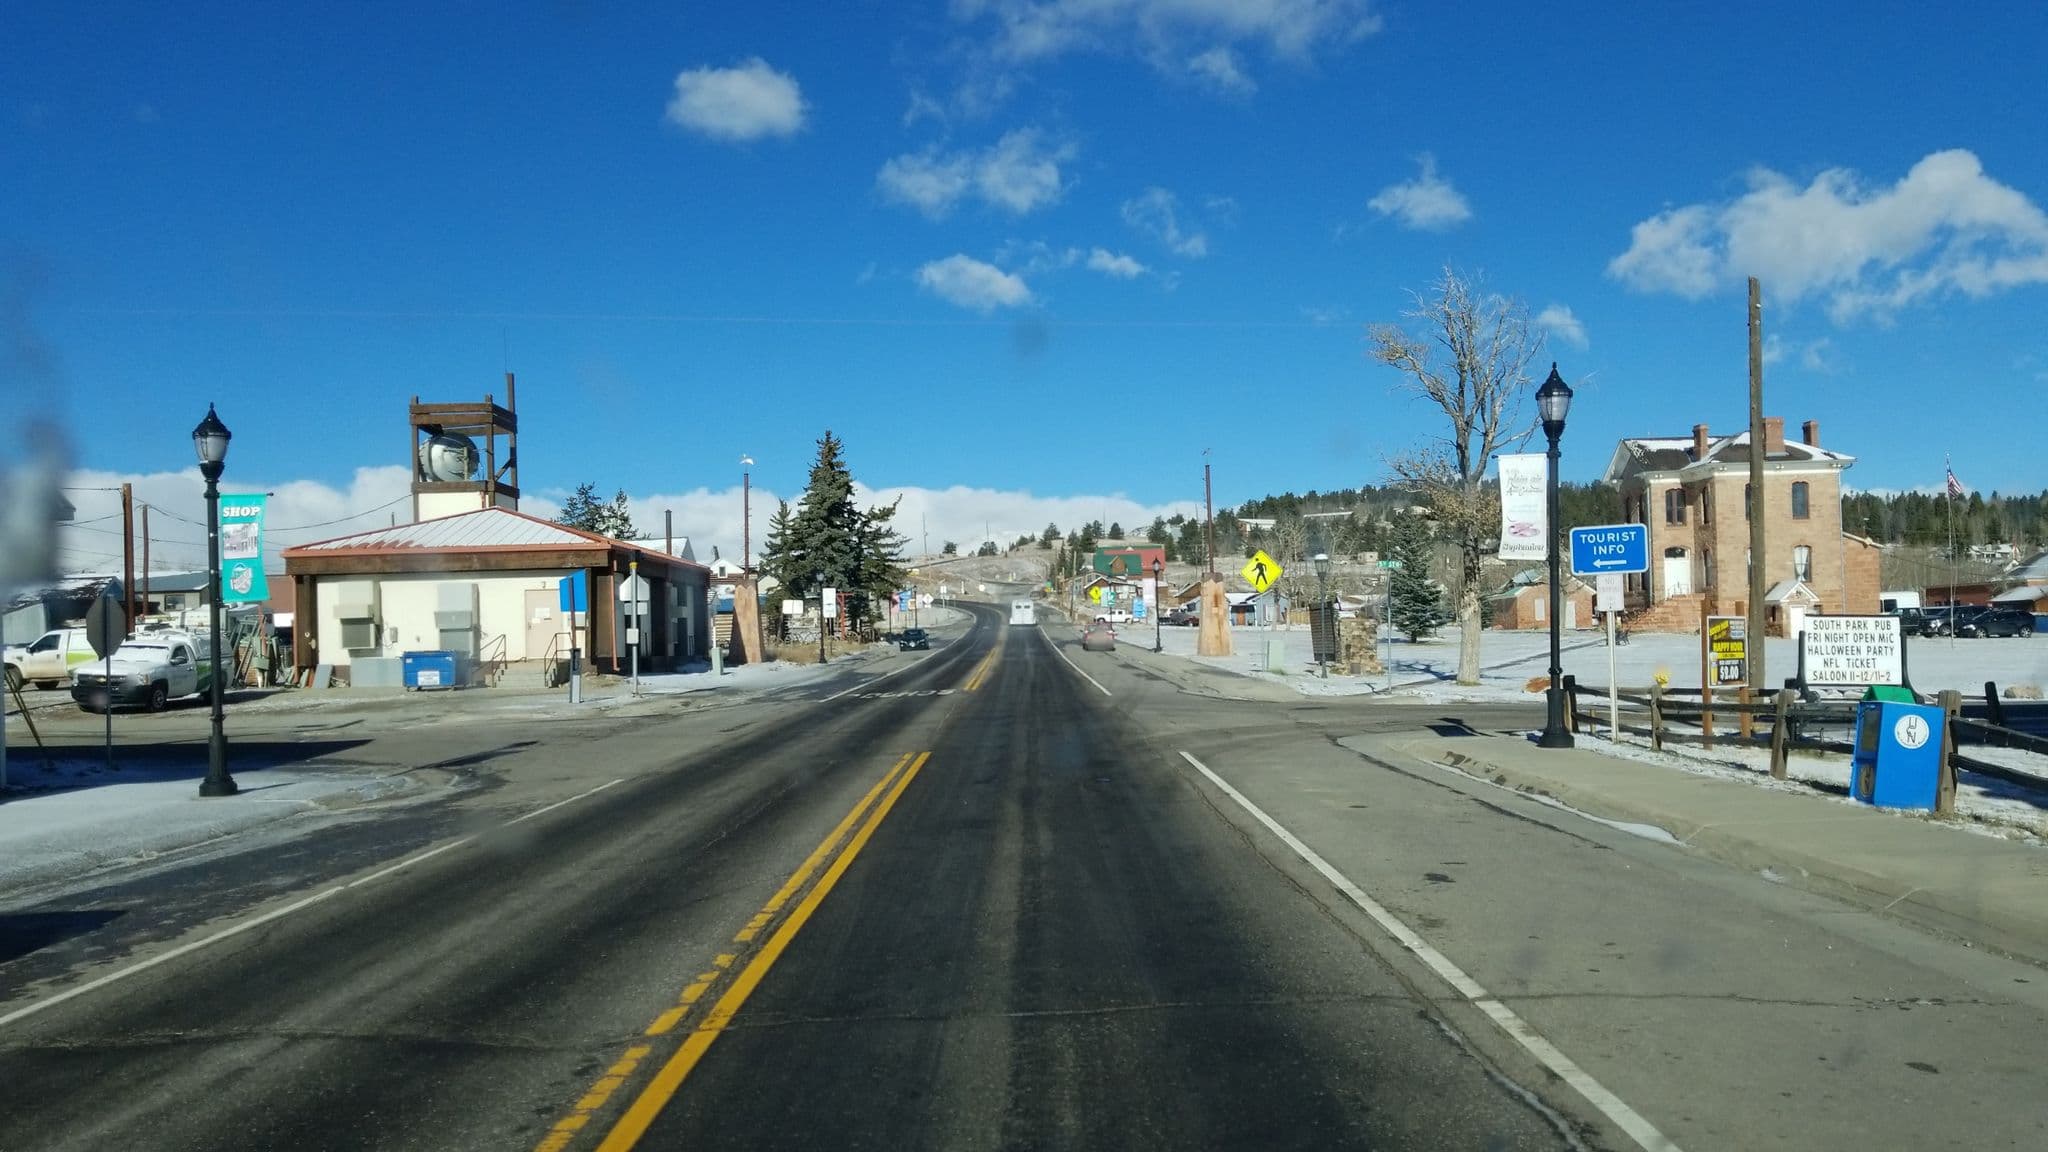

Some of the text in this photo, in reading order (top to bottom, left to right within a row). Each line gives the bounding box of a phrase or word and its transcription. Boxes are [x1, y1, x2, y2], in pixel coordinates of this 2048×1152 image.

[223, 506, 261, 518] SHOP
[1580, 531, 1637, 544] TOURIST
[1593, 544, 1625, 555] INFO
[1813, 620, 1891, 630] SOUTH PARK PUB
[1808, 633, 1821, 643] FRI
[1825, 633, 1849, 643] NIGHT
[1853, 633, 1875, 643] OPEN
[1808, 645, 1894, 656] HALLOWEEN PARTY
[1823, 658, 1840, 668] NFL
[1813, 671, 1847, 681] SALOON
